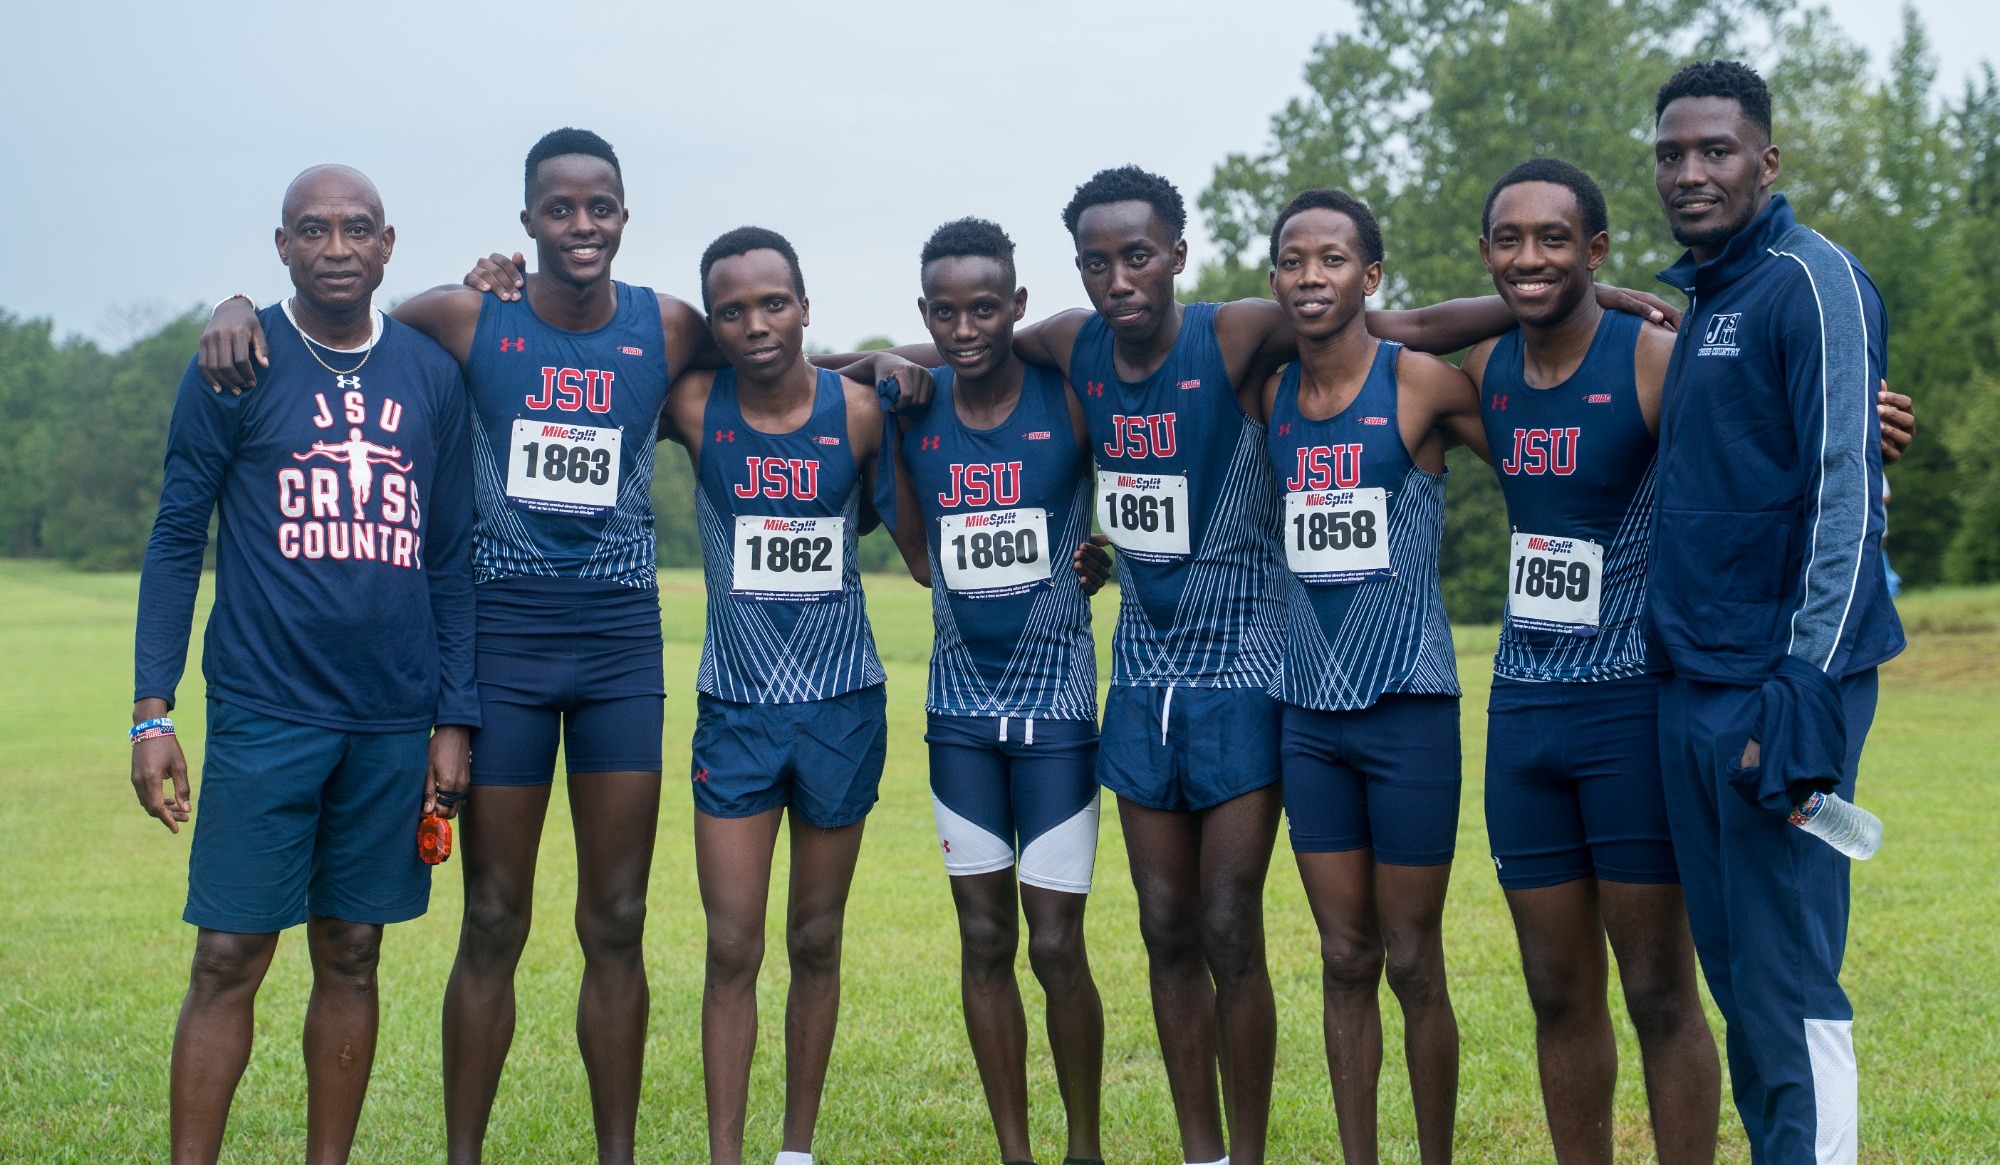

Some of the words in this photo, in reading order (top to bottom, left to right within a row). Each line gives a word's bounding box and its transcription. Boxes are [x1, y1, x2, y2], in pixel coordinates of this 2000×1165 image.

[525, 366, 615, 414] JSU
[312, 390, 402, 433] JSU
[1364, 417, 1388, 425] SWAC
[541, 425, 597, 442] MileSplit
[818, 437, 840, 445] SWAC
[1104, 412, 1176, 459] JSU
[1503, 427, 1581, 476] JSU
[522, 441, 611, 486] 1863
[734, 456, 820, 501] JSU
[1117, 475, 1161, 491] MileSplit
[1286, 443, 1363, 492] JSU
[938, 461, 1022, 508] JSU
[1305, 492, 1354, 507] MileSplit
[763, 518, 816, 533] MileSplit
[965, 512, 1017, 527] MileSplit
[1105, 492, 1175, 533] 1861
[1293, 510, 1377, 551] 1858
[746, 535, 833, 573] 1862
[951, 528, 1039, 571] 1860
[1528, 537, 1573, 555] MileSplit
[1515, 555, 1591, 602] 1859
